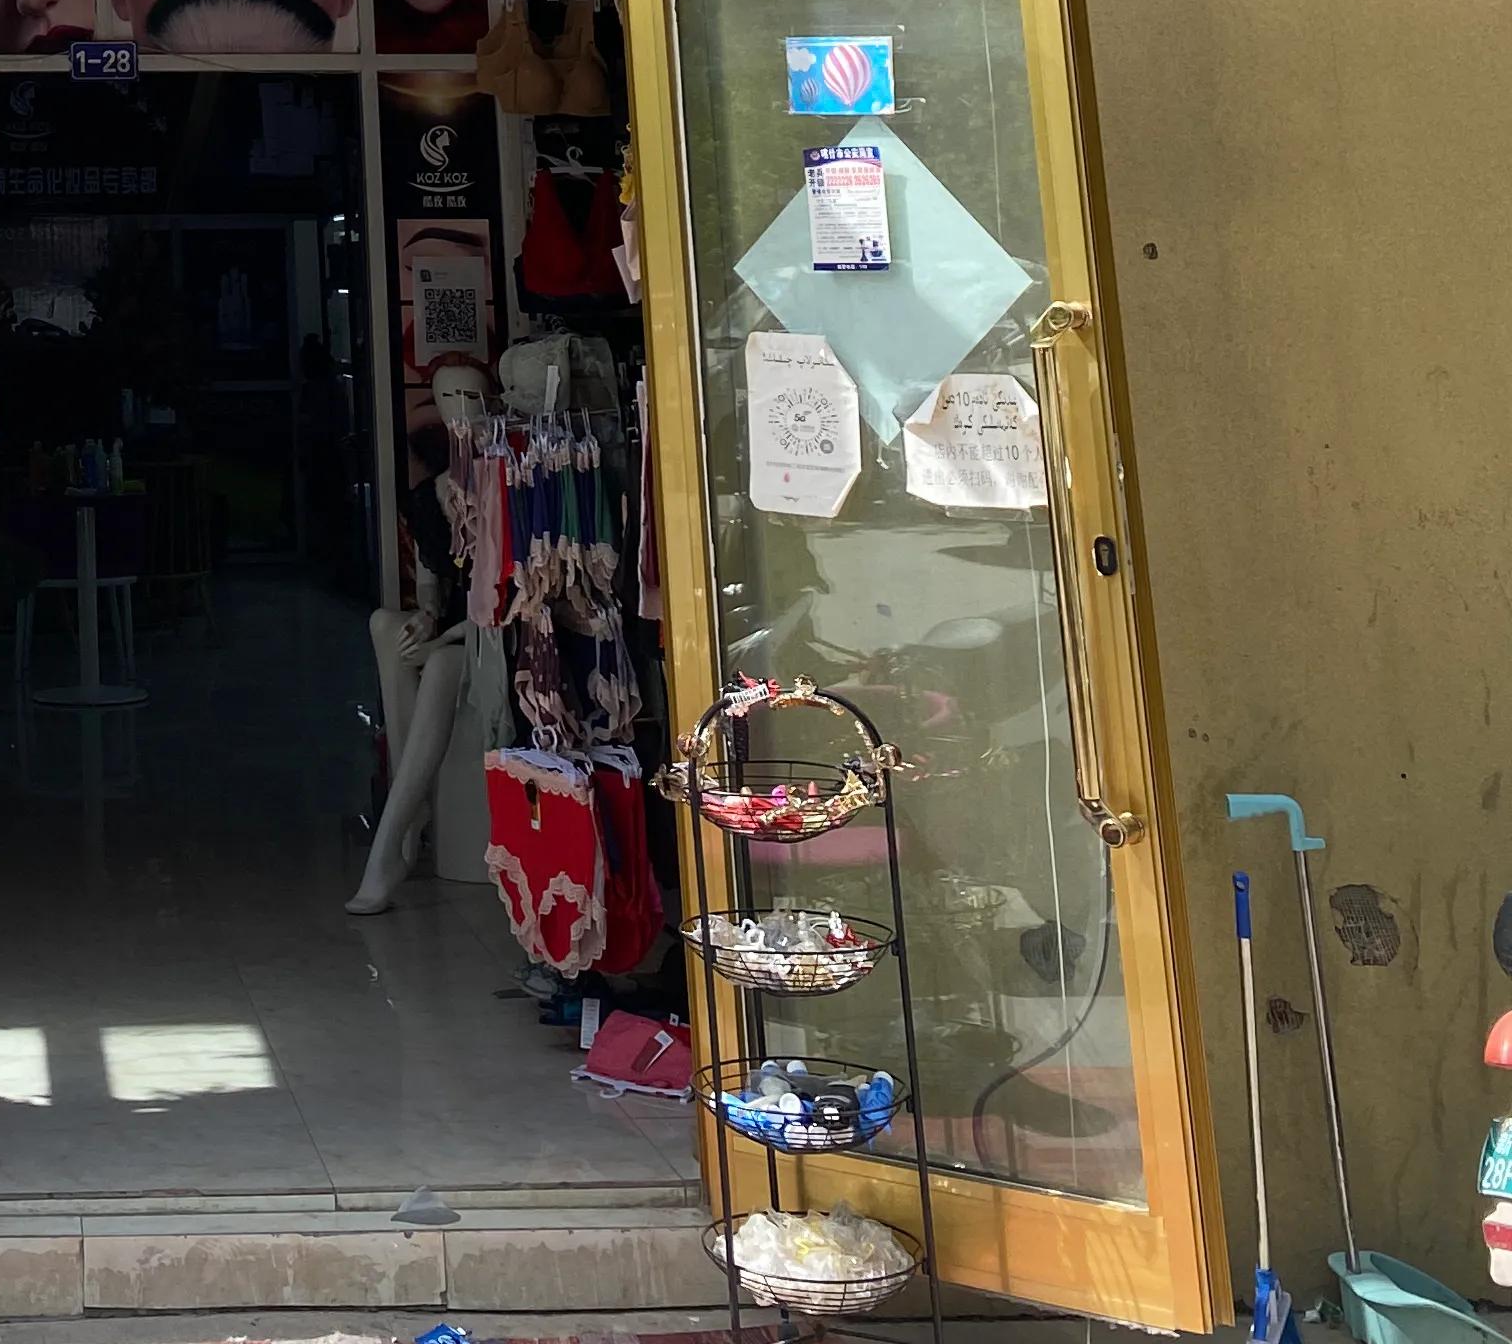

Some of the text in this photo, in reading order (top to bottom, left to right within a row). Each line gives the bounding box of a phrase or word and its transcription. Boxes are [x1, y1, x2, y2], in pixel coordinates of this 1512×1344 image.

[76, 50, 131, 73] 1-28
[416, 172, 468, 184] KOZ KOZ
